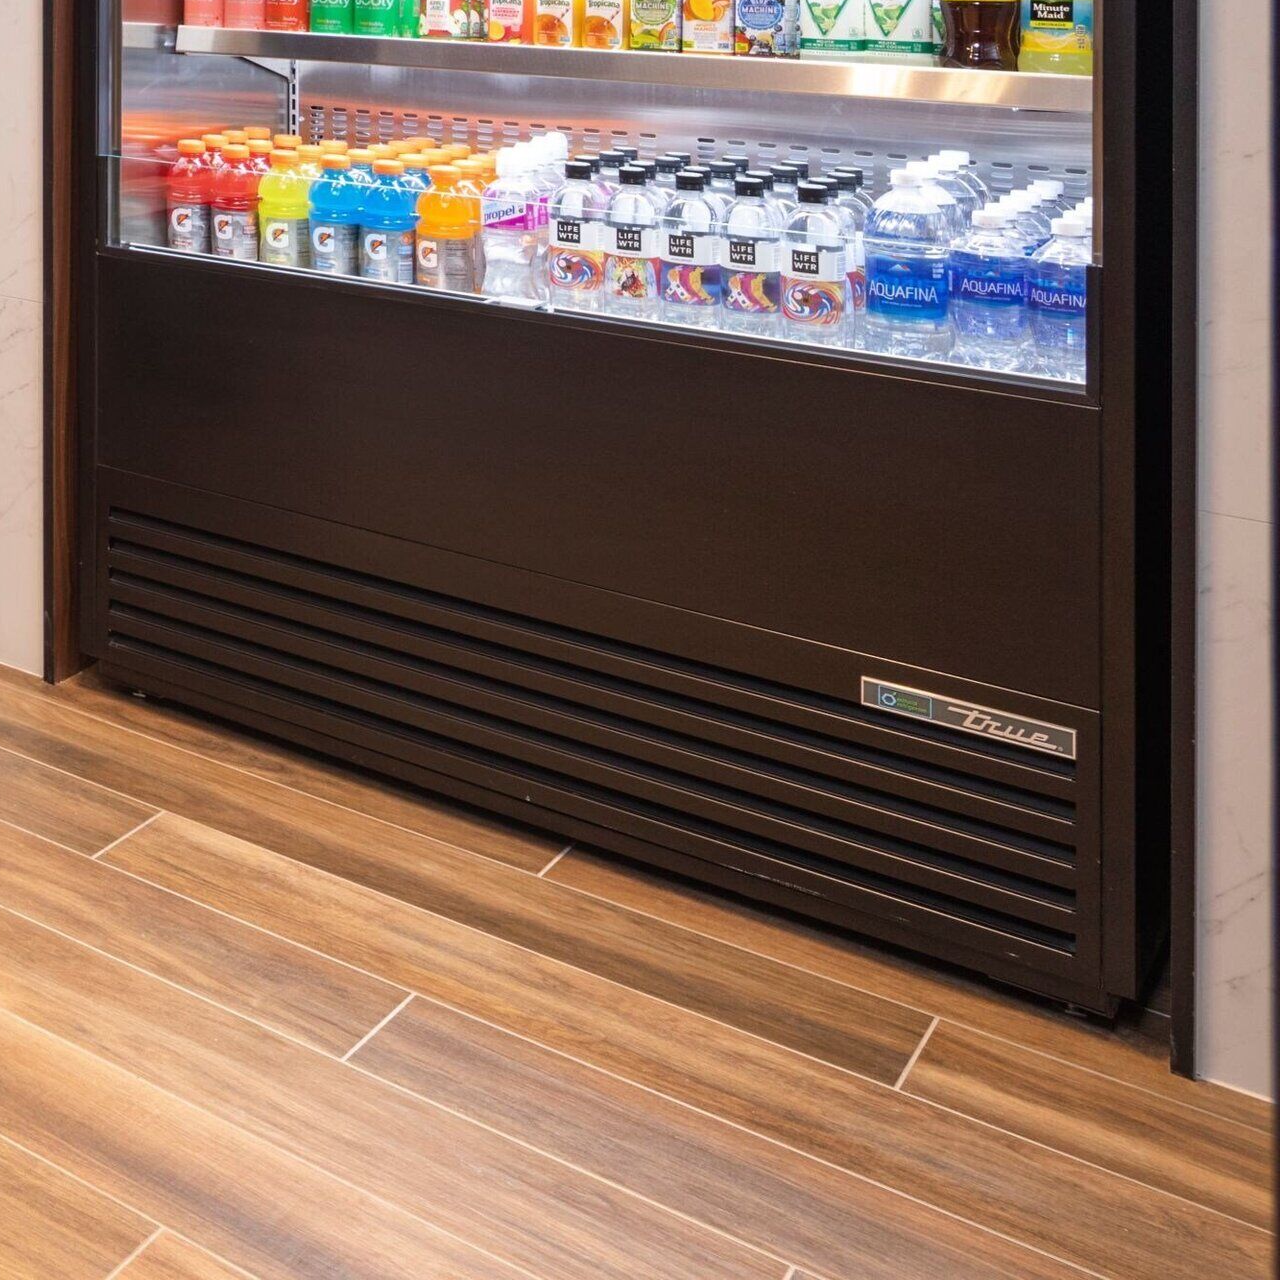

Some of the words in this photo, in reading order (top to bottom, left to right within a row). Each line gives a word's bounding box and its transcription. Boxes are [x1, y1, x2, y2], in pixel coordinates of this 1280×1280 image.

[635, 1, 670, 10] MACHINE
[1032, 3, 1070, 14] Minute
[741, 7, 780, 15] MACHINE
[1037, 10, 1065, 20] Maid
[484, 206, 515, 224] propel
[558, 224, 578, 234] LIFE
[558, 232, 579, 241] WTR
[618, 231, 640, 241] LIFE
[617, 239, 640, 249] WTR
[670, 237, 692, 247] LIFE
[670, 245, 692, 255] WTR
[731, 244, 753, 254] LIFE
[731, 252, 754, 262] WTR
[869, 279, 939, 304] AQUAFINA
[961, 278, 1024, 296] AQUAFINA
[947, 706, 1059, 751] true
